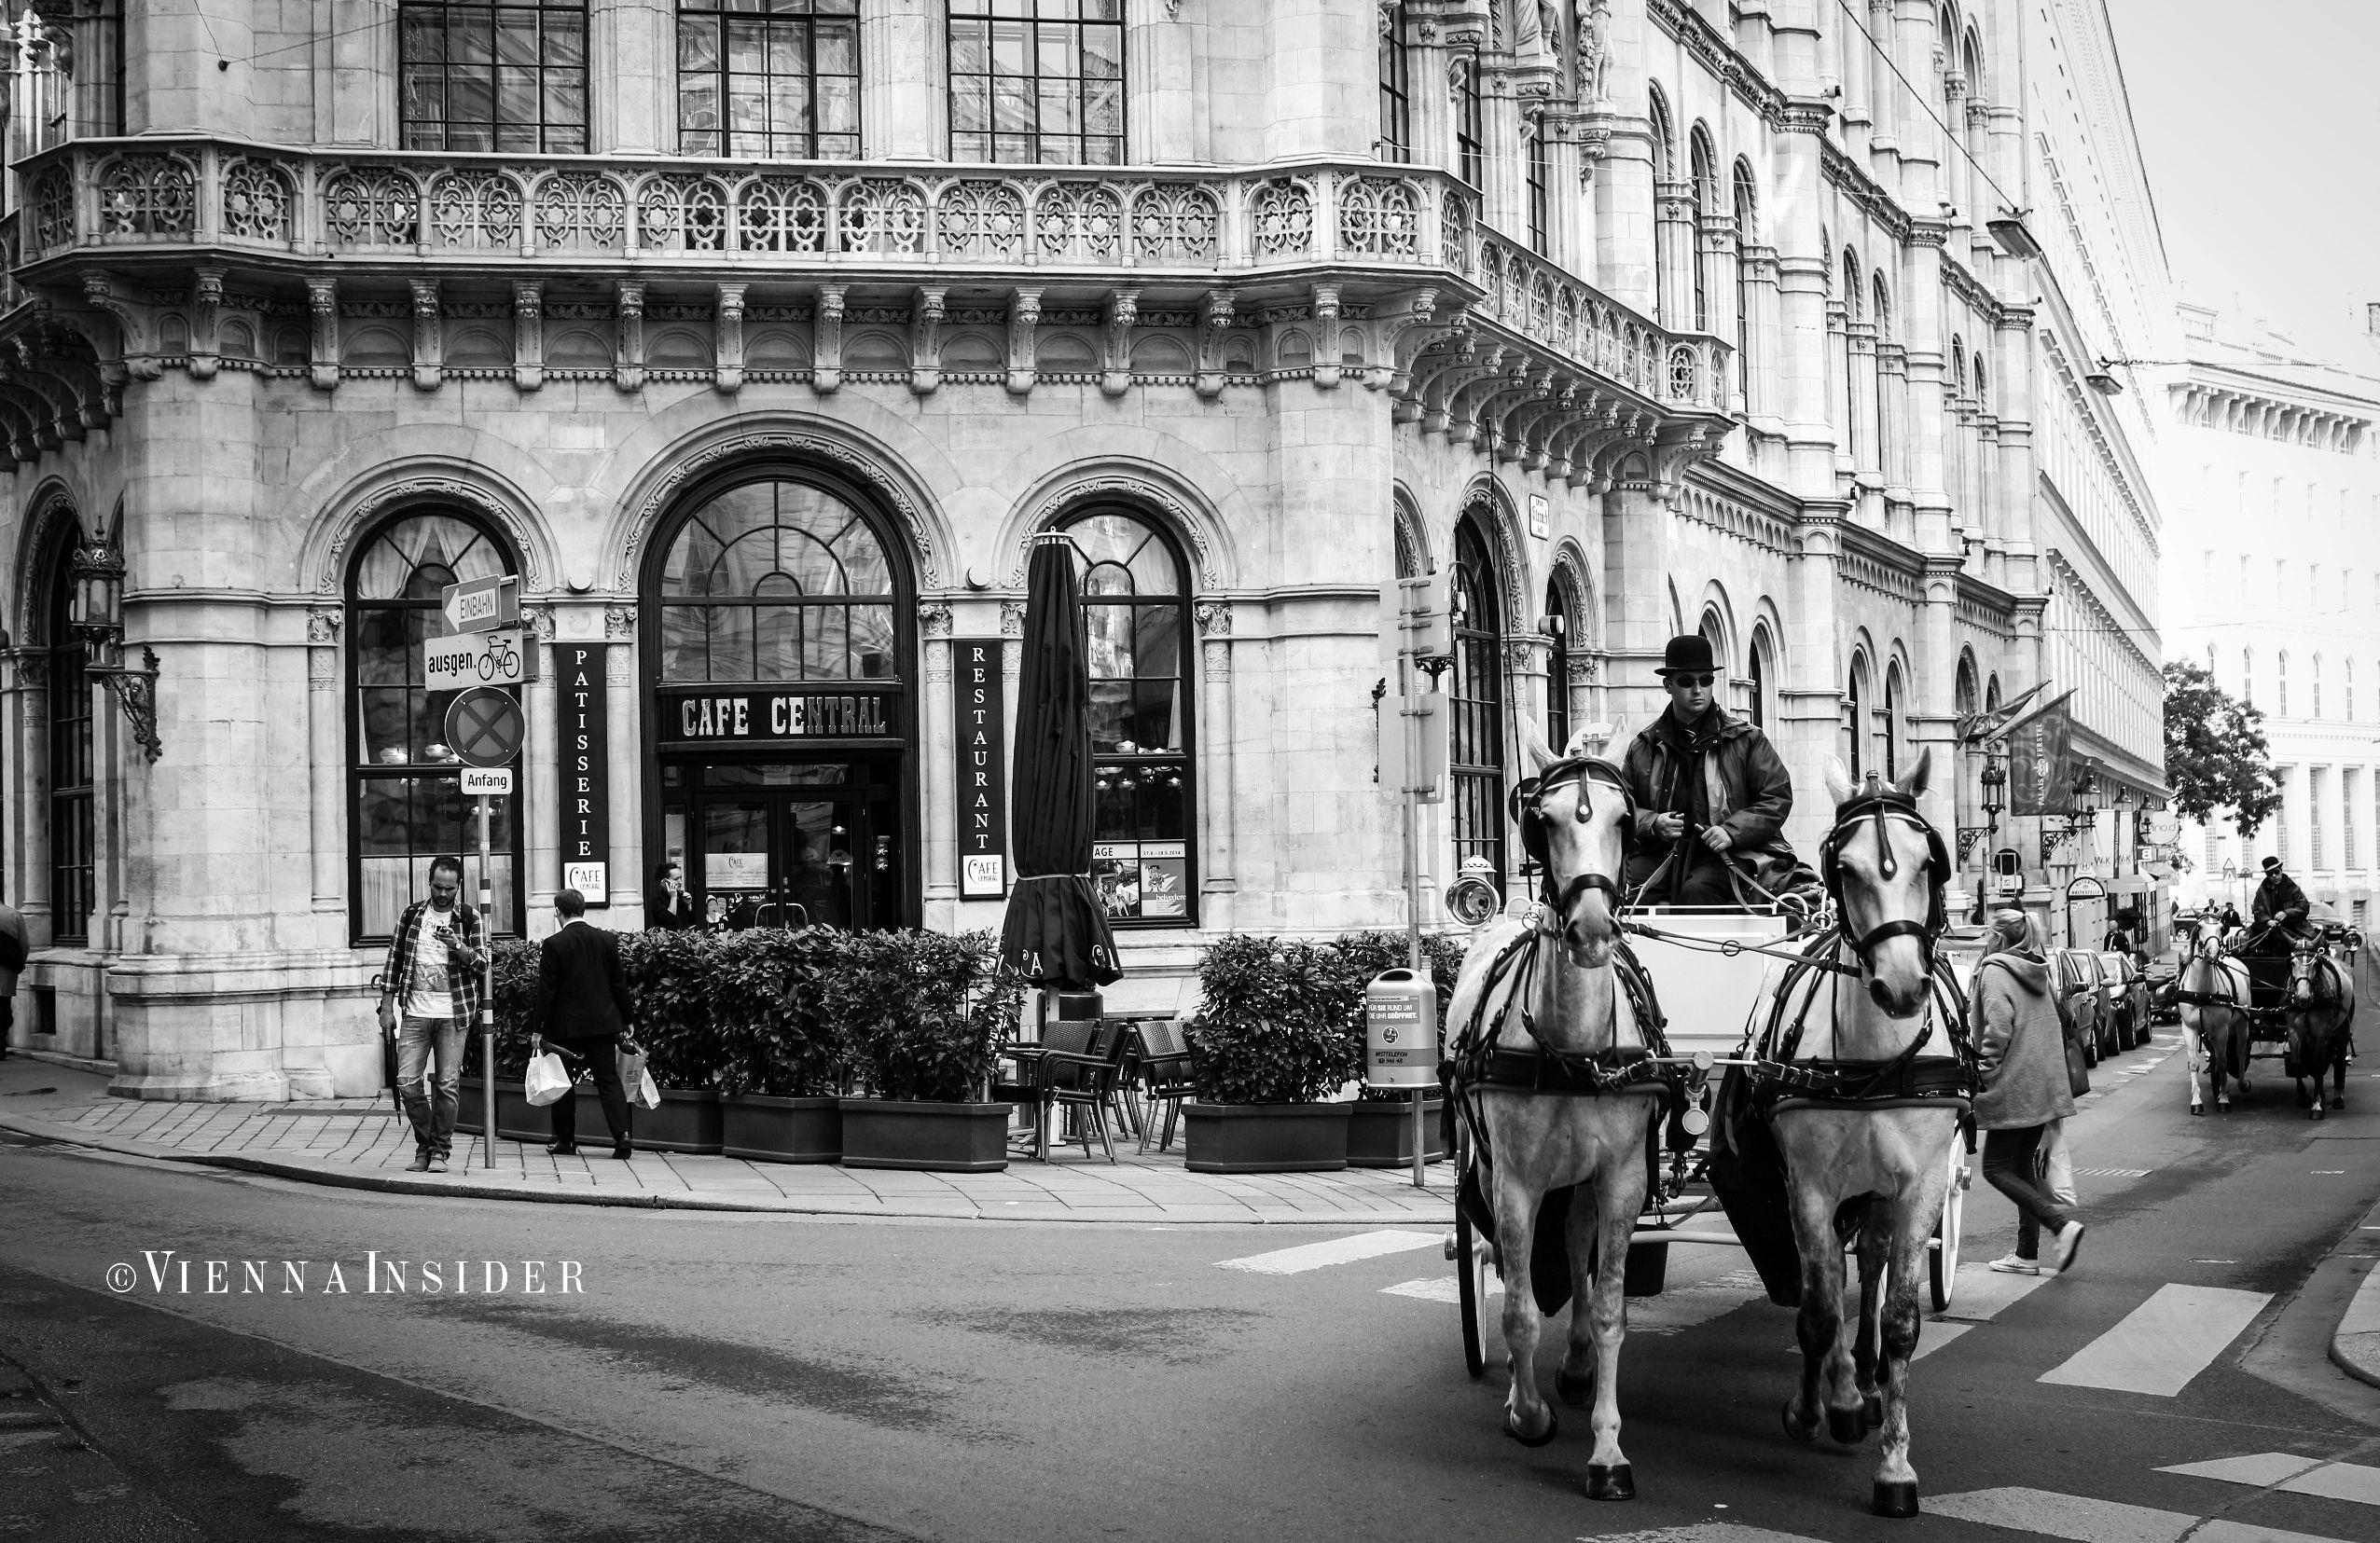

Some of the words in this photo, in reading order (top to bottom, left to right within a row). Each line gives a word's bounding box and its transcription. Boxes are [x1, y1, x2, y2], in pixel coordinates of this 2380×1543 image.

[460, 592, 494, 619] EINBAHN
[429, 652, 477, 677] ausgen.
[682, 697, 749, 736] CAFE
[771, 696, 886, 735] CENTRAL
[574, 650, 591, 856] PATISSERIE
[972, 647, 989, 849] RESTAURANT
[2035, 723, 2043, 757] FERSTEL
[467, 774, 507, 790] Anfang
